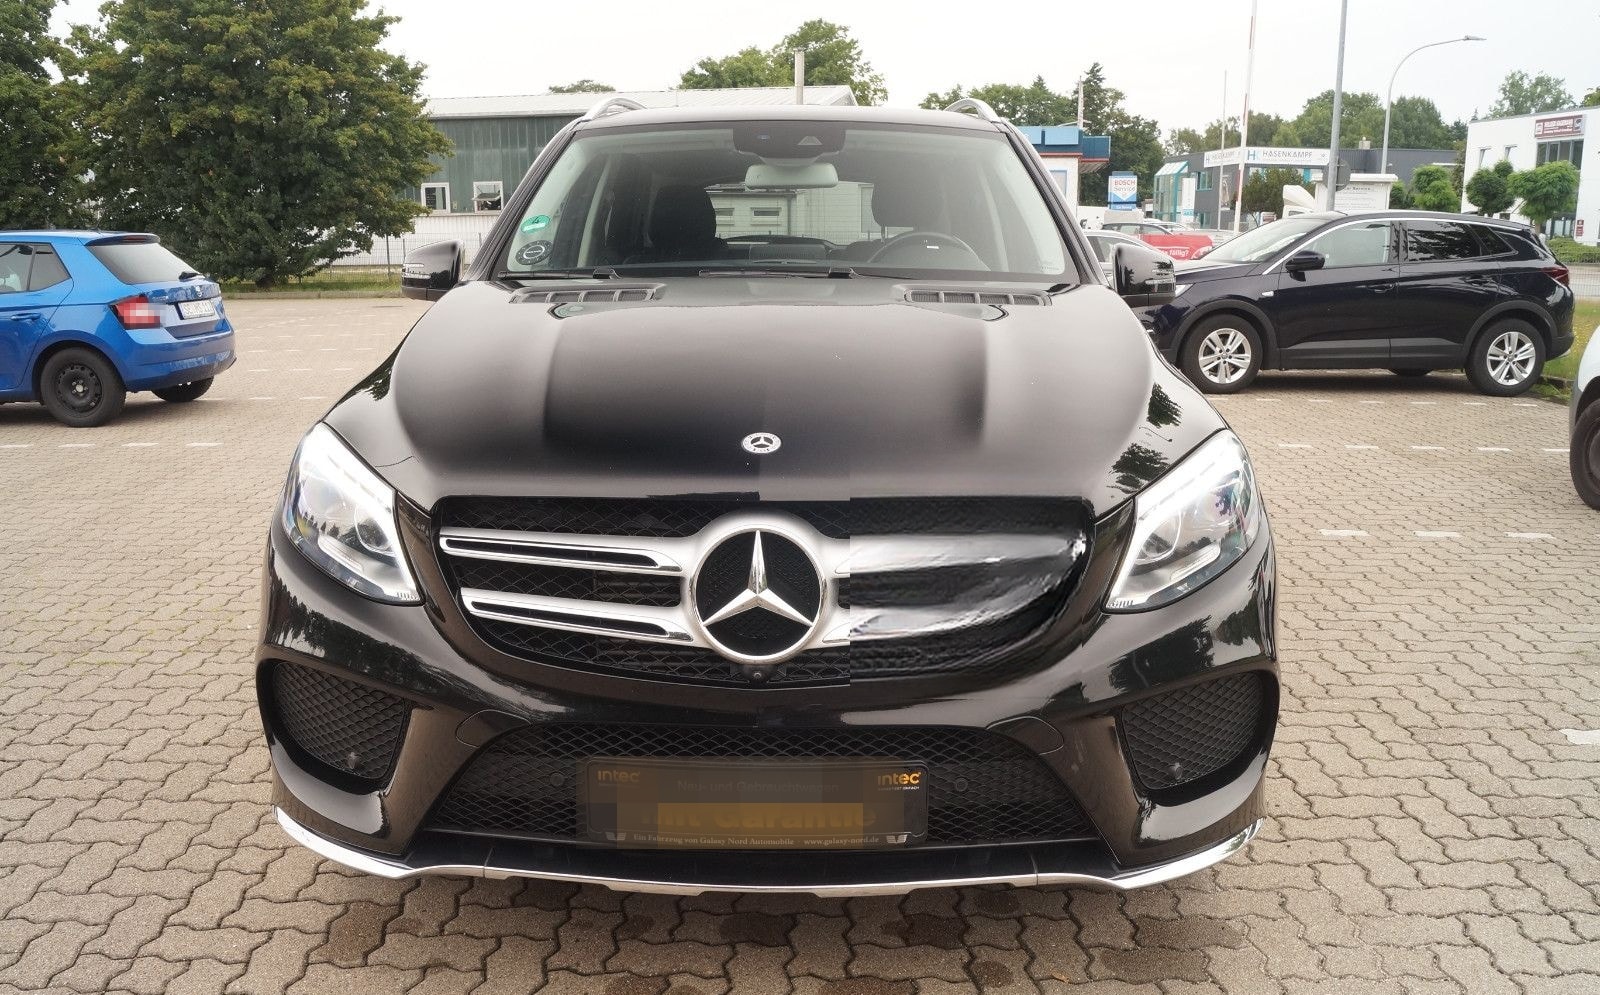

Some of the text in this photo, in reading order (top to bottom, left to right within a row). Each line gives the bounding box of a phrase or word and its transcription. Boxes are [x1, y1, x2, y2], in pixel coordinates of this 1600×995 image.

[1263, 150, 1313, 158] HASENKAMPF
[1169, 249, 1189, 258] fällig?
[598, 770, 640, 783] intec
[878, 773, 921, 785] intec
[710, 781, 733, 792] und
[633, 833, 647, 841] Ein
[648, 834, 683, 845] Fahrzeug
[699, 837, 726, 846] Galaxy
[727, 837, 749, 845] Nord
[750, 837, 794, 846] Automobile
[803, 836, 880, 847] www.galaxy-nord.de
